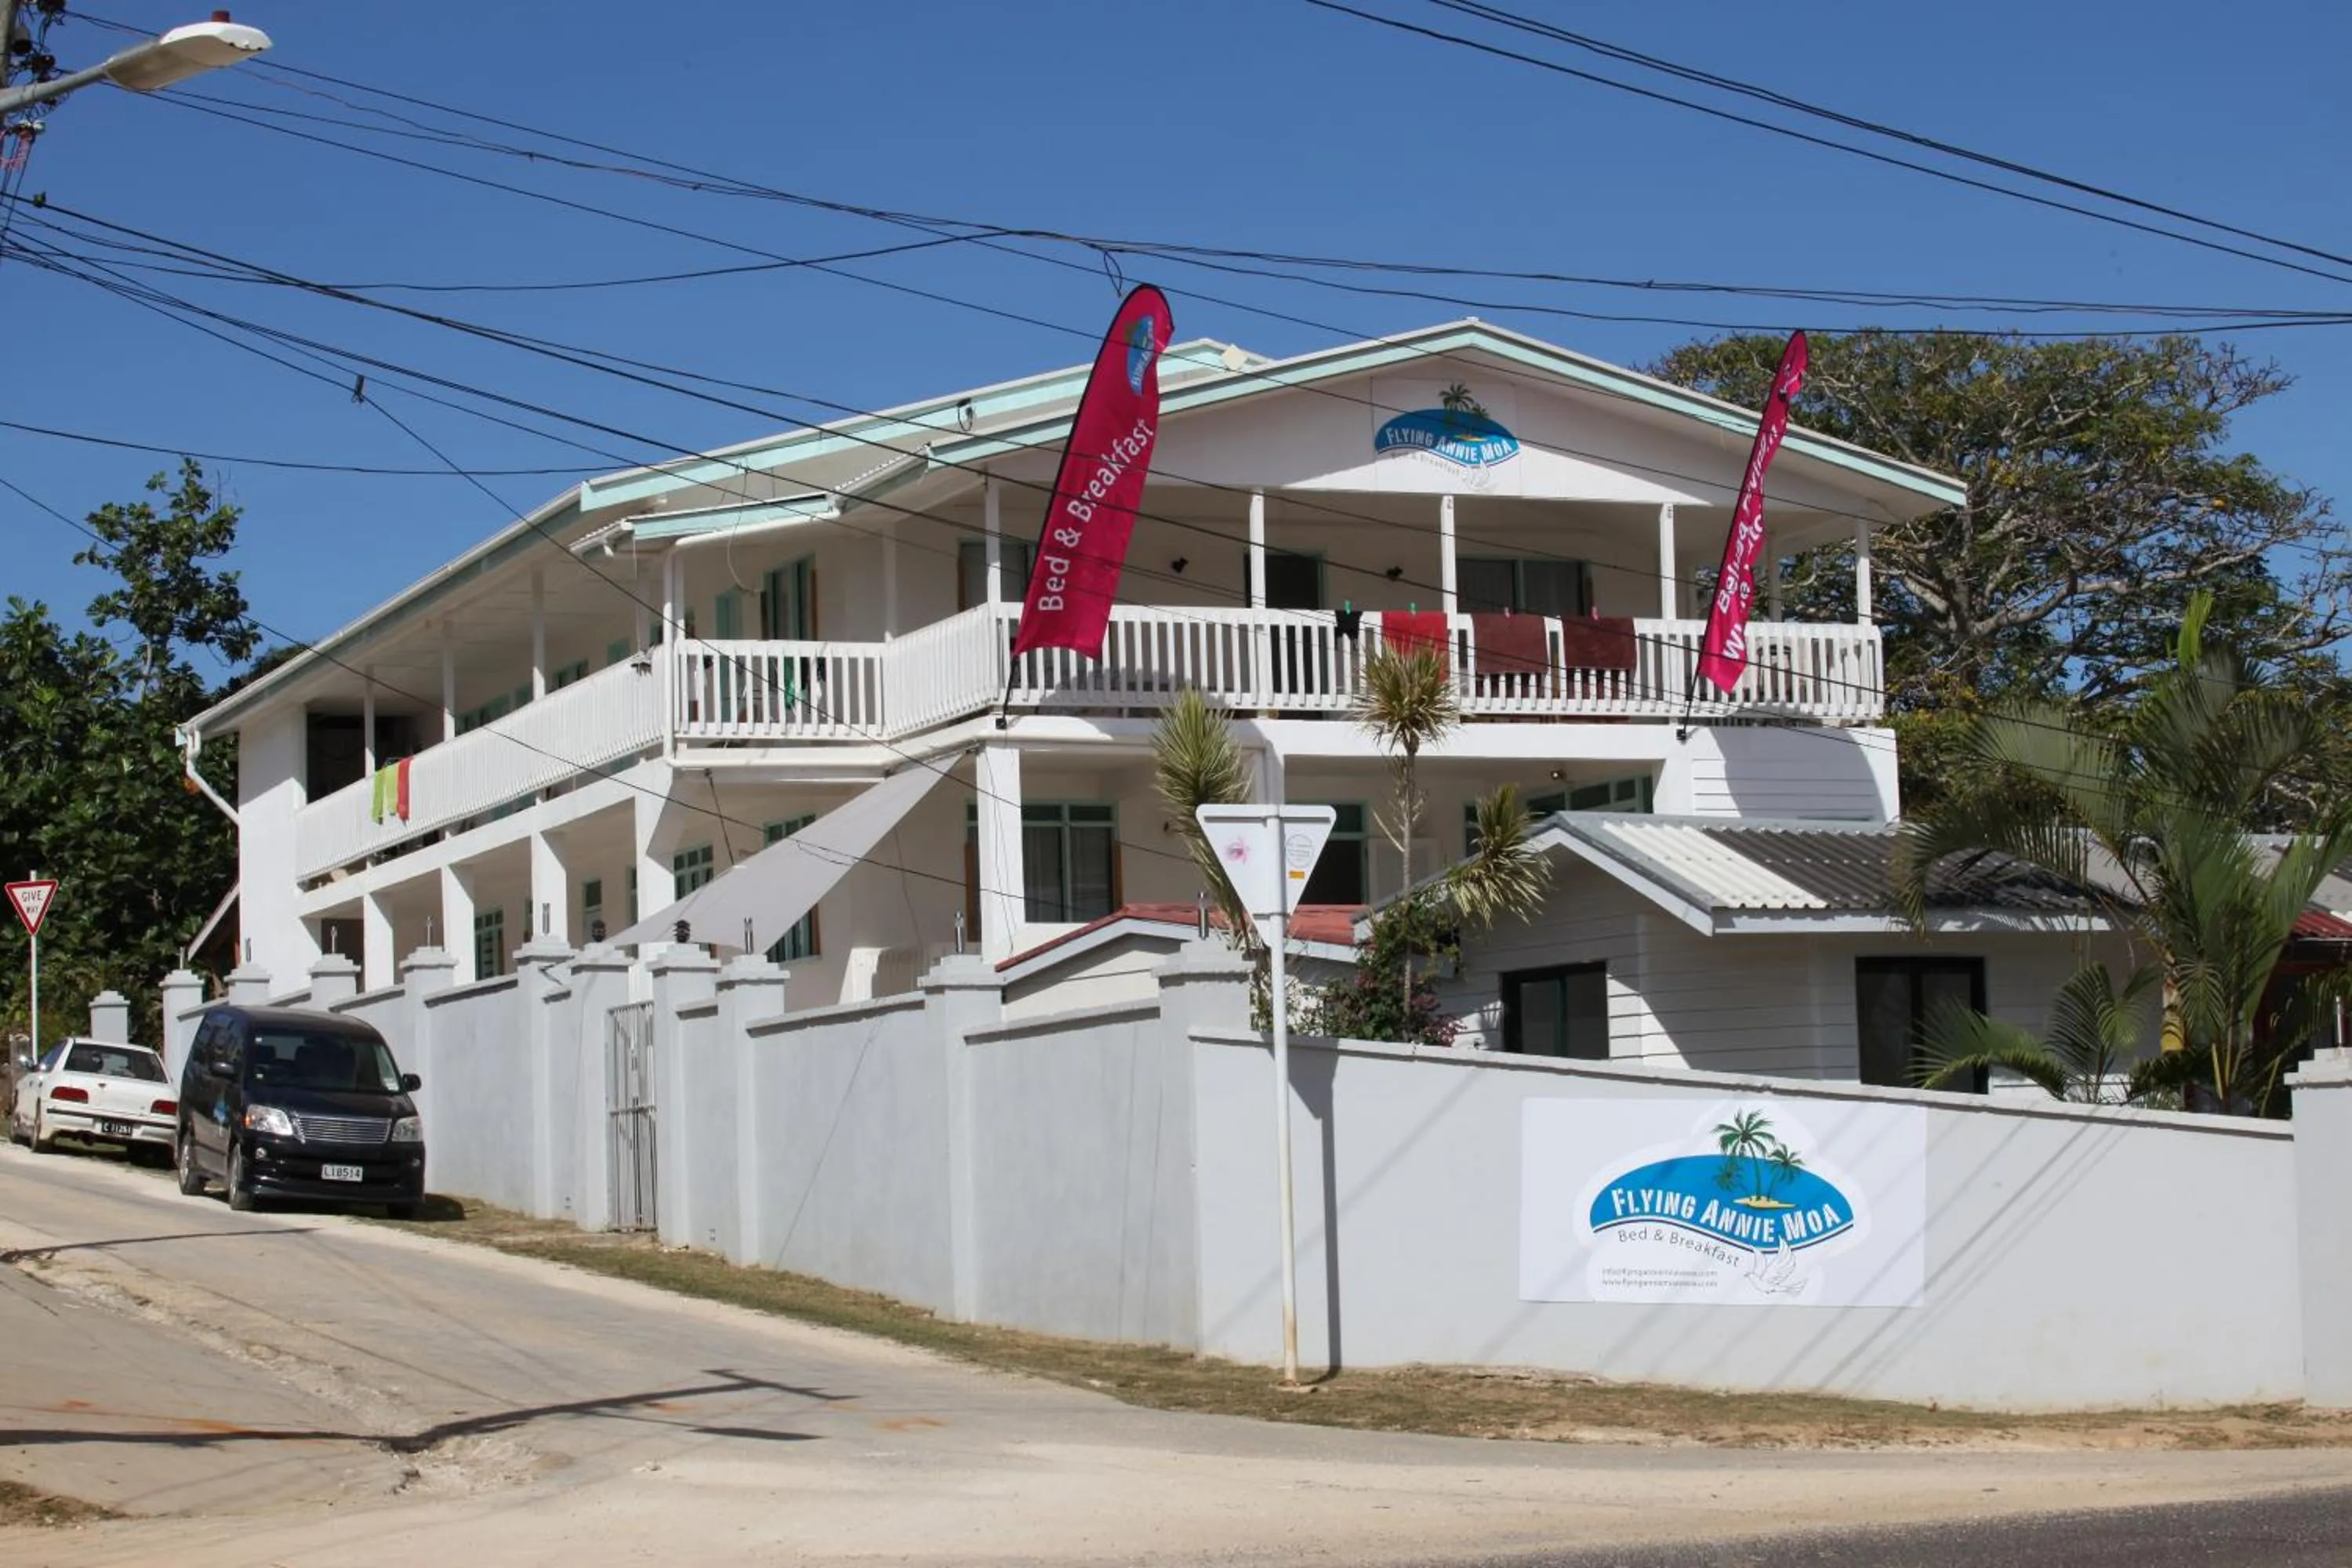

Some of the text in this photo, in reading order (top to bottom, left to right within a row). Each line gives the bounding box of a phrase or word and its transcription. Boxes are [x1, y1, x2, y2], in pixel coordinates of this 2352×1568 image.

[1385, 427, 1512, 462] FLYING ANNIE MOA
[1066, 418, 1154, 523] Breakfast
[1054, 527, 1082, 548] &
[1038, 555, 1070, 611] Bed
[22, 890, 42, 902] GIVE
[1611, 1188, 1841, 1243] FLYING ANNIE MOA
[1617, 1225, 1740, 1268] Bed & Breakfast
